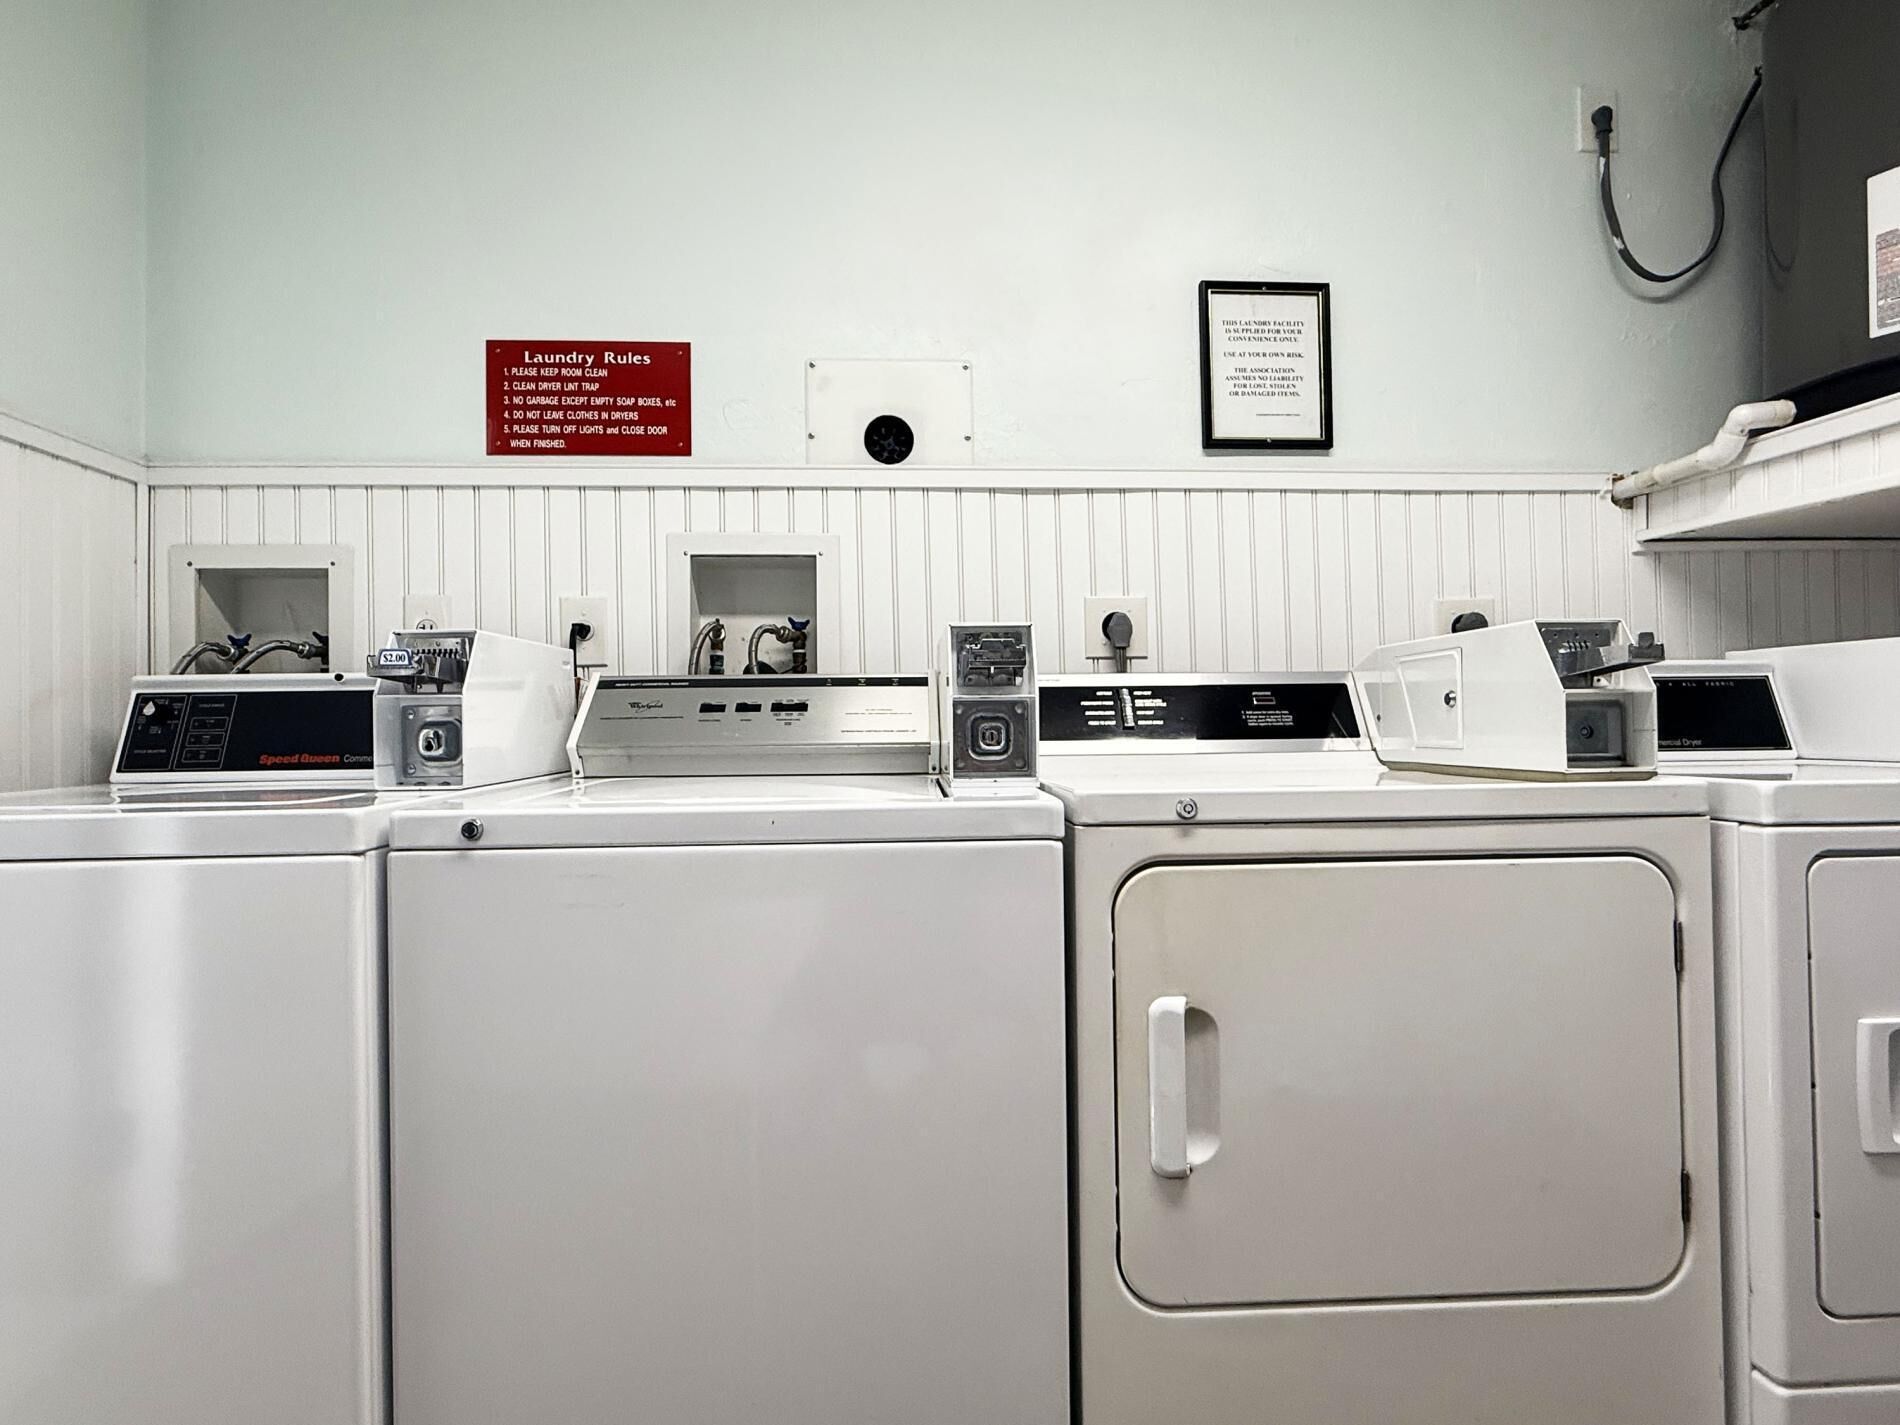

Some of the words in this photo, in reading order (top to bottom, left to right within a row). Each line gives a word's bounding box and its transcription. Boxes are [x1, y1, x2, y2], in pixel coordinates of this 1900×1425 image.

[524, 351, 594, 366] Laundry
[604, 352, 651, 364] Rules
[504, 368, 509, 376] 1.
[512, 368, 538, 377] PLEASE
[541, 368, 558, 377] KEEP
[561, 368, 582, 377] ROOM
[585, 368, 608, 377] CLEAN
[504, 382, 510, 390] 2.
[513, 382, 536, 391] CLEAN
[538, 382, 561, 391] DRYER
[564, 382, 579, 391] LINT
[581, 383, 599, 391] TRAP
[513, 397, 523, 405] NO
[526, 397, 559, 405] GARBAGE
[561, 397, 588, 406] EXCEPT
[590, 397, 613, 406] EMPTY
[616, 397, 635, 406] SOAP
[638, 398, 663, 408] BOXES,
[665, 399, 676, 407] etc
[504, 411, 511, 419] 4.
[513, 411, 524, 419] DO
[526, 411, 540, 419] NOT
[543, 411, 564, 420] LEAVE
[566, 411, 598, 420] CLOTHES
[601, 412, 609, 420] IN
[611, 412, 638, 420] DRYERS
[513, 426, 539, 434] PLEASE
[542, 426, 560, 434] TURN
[563, 426, 576, 434] OFF
[579, 426, 603, 434] LIGHTS
[606, 426, 619, 435] and
[621, 426, 645, 435] CLOSE
[647, 427, 667, 435] DOOR
[510, 440, 531, 448] WHEN
[534, 440, 566, 448] FINISHED.
[384, 653, 406, 663] $2.00
[1682, 738, 1702, 747] Dryer
[259, 754, 298, 766] Speed
[300, 754, 339, 763] Queen
